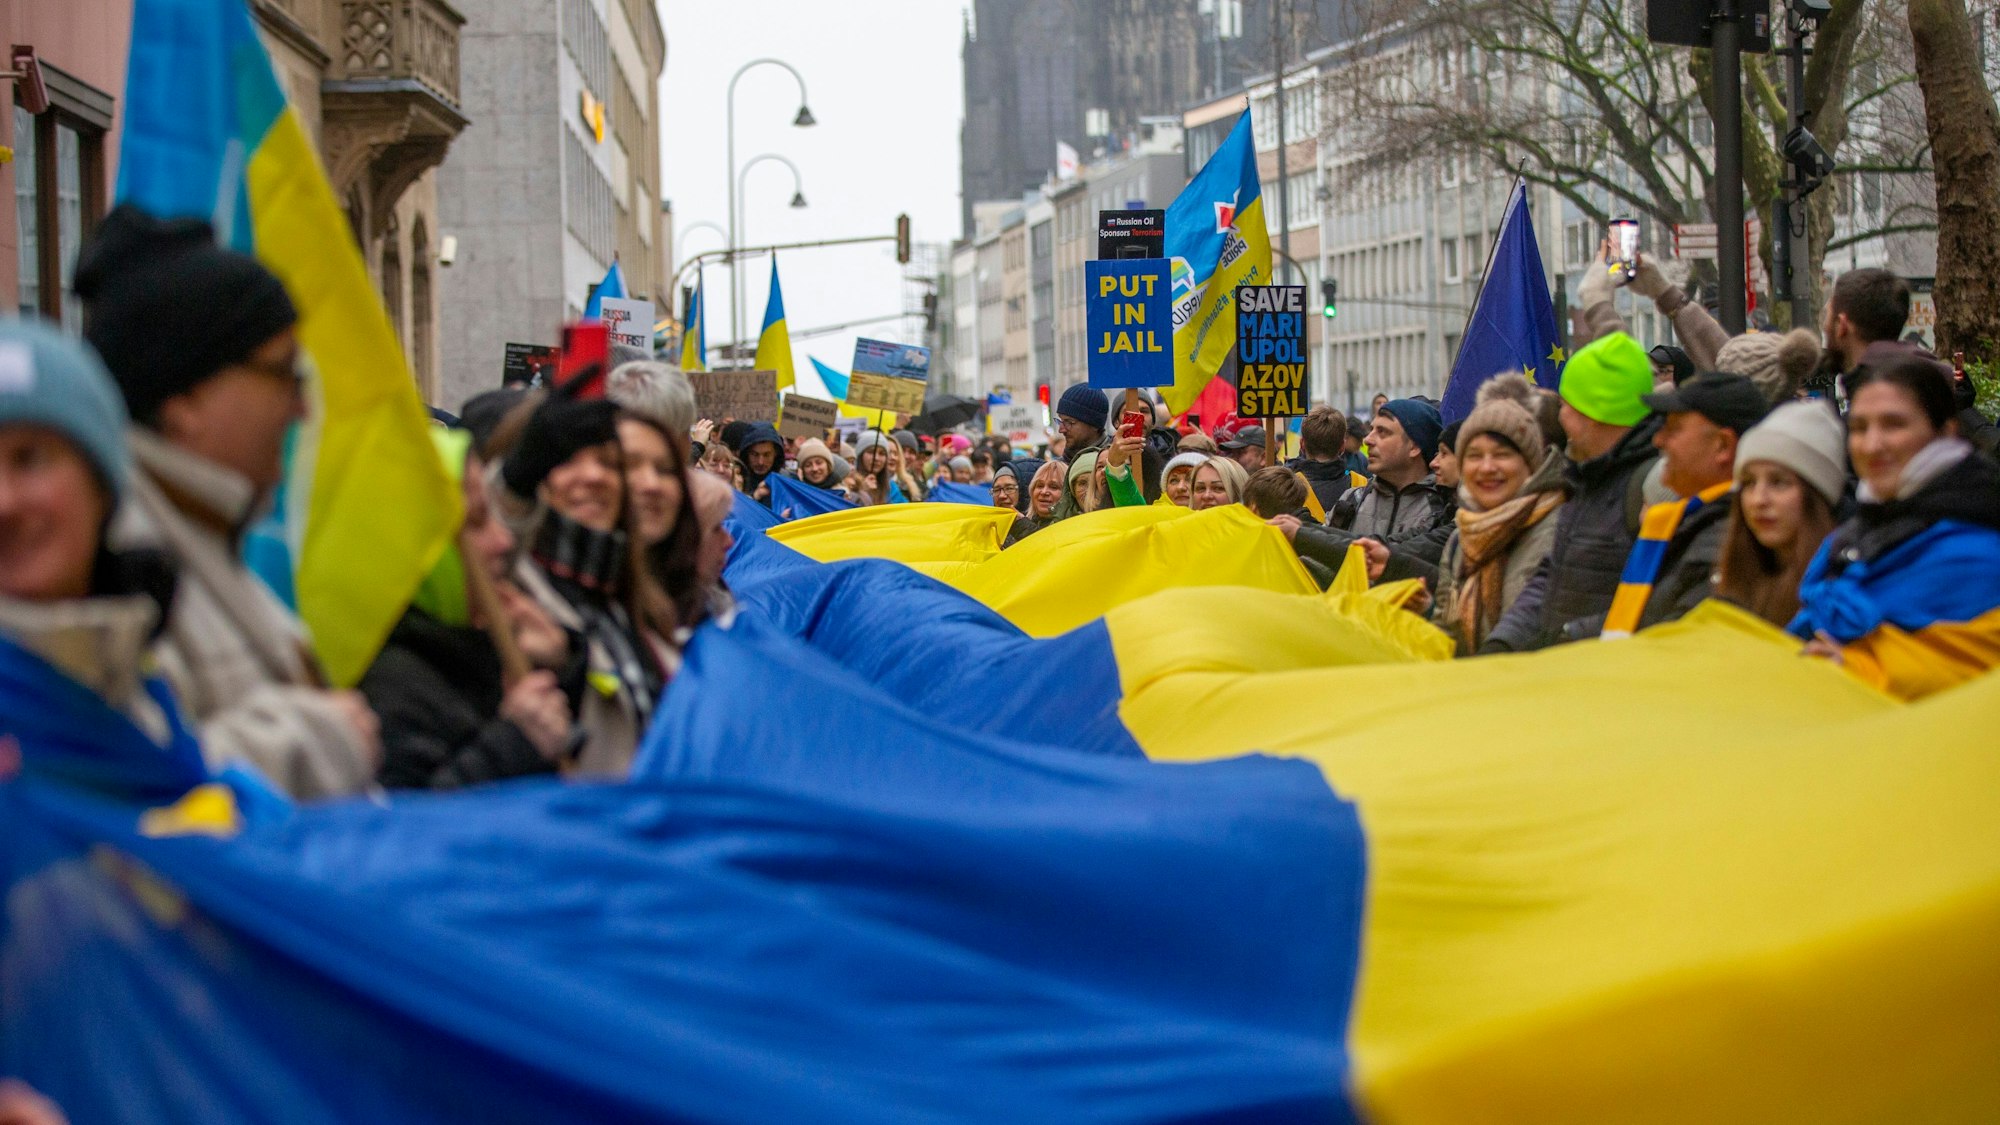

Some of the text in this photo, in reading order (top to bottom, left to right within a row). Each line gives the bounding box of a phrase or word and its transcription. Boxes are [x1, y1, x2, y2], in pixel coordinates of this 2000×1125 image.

[1116, 216, 1154, 226] Russian Oil
[1099, 228, 1163, 239] Sponsors Terrorism
[1099, 274, 1159, 298] PUT
[1239, 287, 1303, 312] SAVE
[1113, 303, 1146, 325] IN
[1240, 313, 1302, 338] MARI
[1098, 331, 1163, 354] JAIL
[1240, 338, 1305, 363] UPOL
[1240, 364, 1305, 389] AZOV
[1241, 390, 1306, 415] STAL
